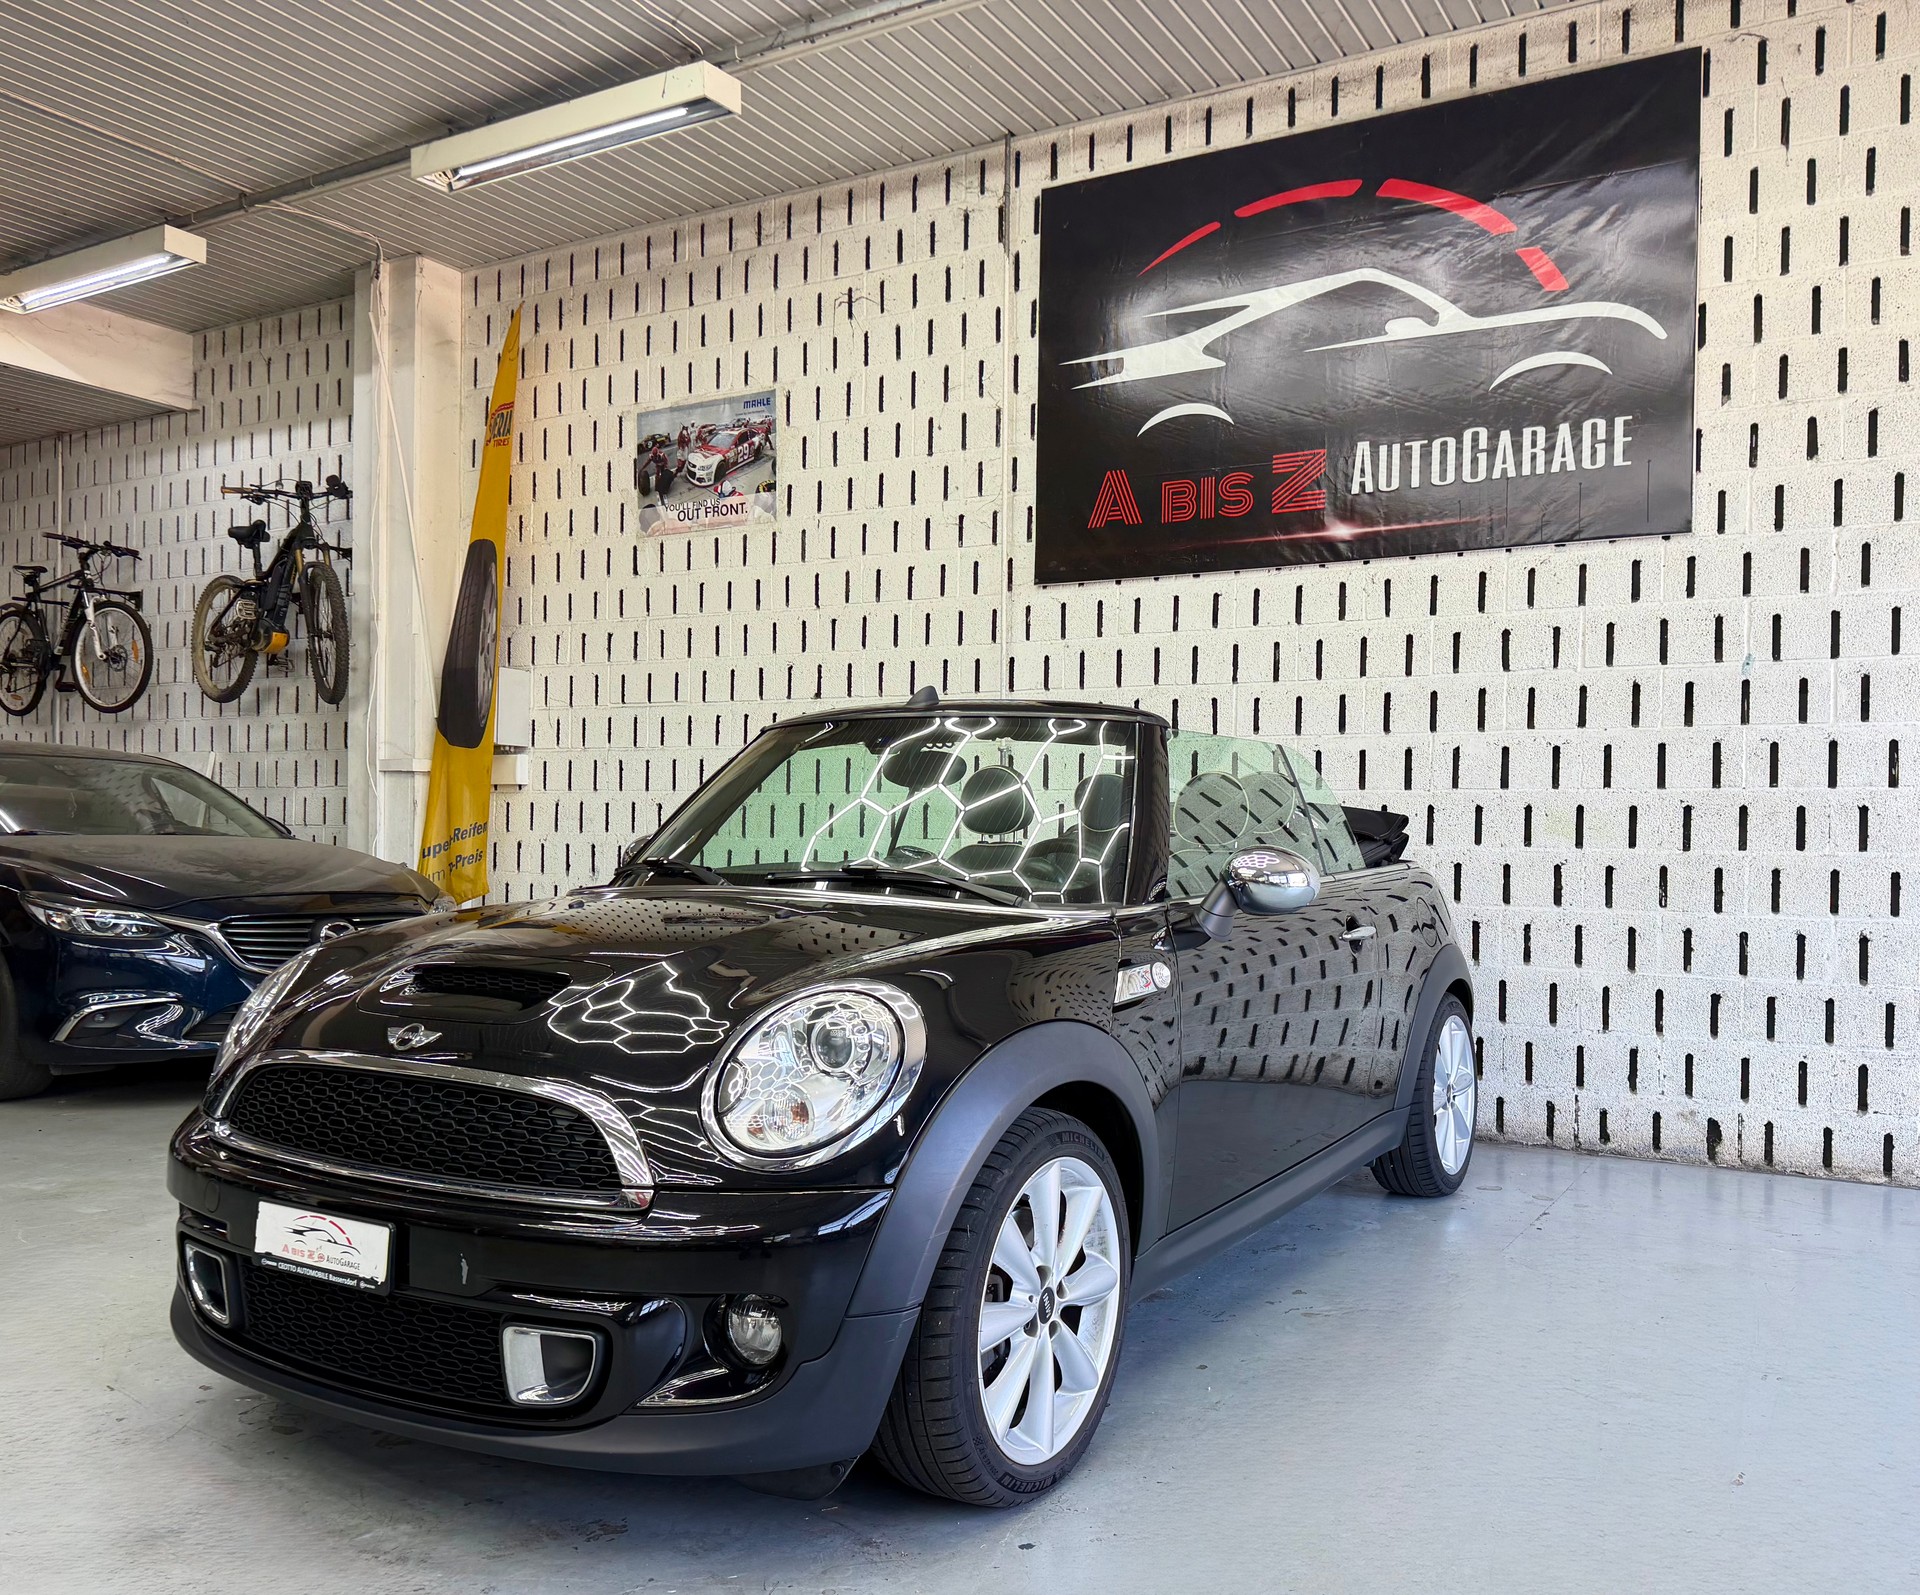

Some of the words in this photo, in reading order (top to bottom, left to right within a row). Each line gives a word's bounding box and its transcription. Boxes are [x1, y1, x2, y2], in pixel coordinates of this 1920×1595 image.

[743, 397, 771, 410] MAHLE
[737, 443, 749, 463] 29
[1087, 469, 1143, 529] A
[1161, 471, 1255, 525] BIS
[1271, 449, 1327, 515] Z
[677, 508, 702, 522] OUT
[705, 502, 748, 518] FRONT.
[693, 499, 708, 508] FND
[711, 498, 721, 506] US
[422, 821, 488, 859] uper-Reifen
[1061, 1131, 1104, 1160] MICHELIN
[281, 1243, 290, 1254] A
[306, 1249, 316, 1260] Z
[296, 1265, 329, 1280] AUTOMOBILE
[1042, 1292, 1052, 1319] MINI
[1001, 1474, 1054, 1494] MICHELIN
